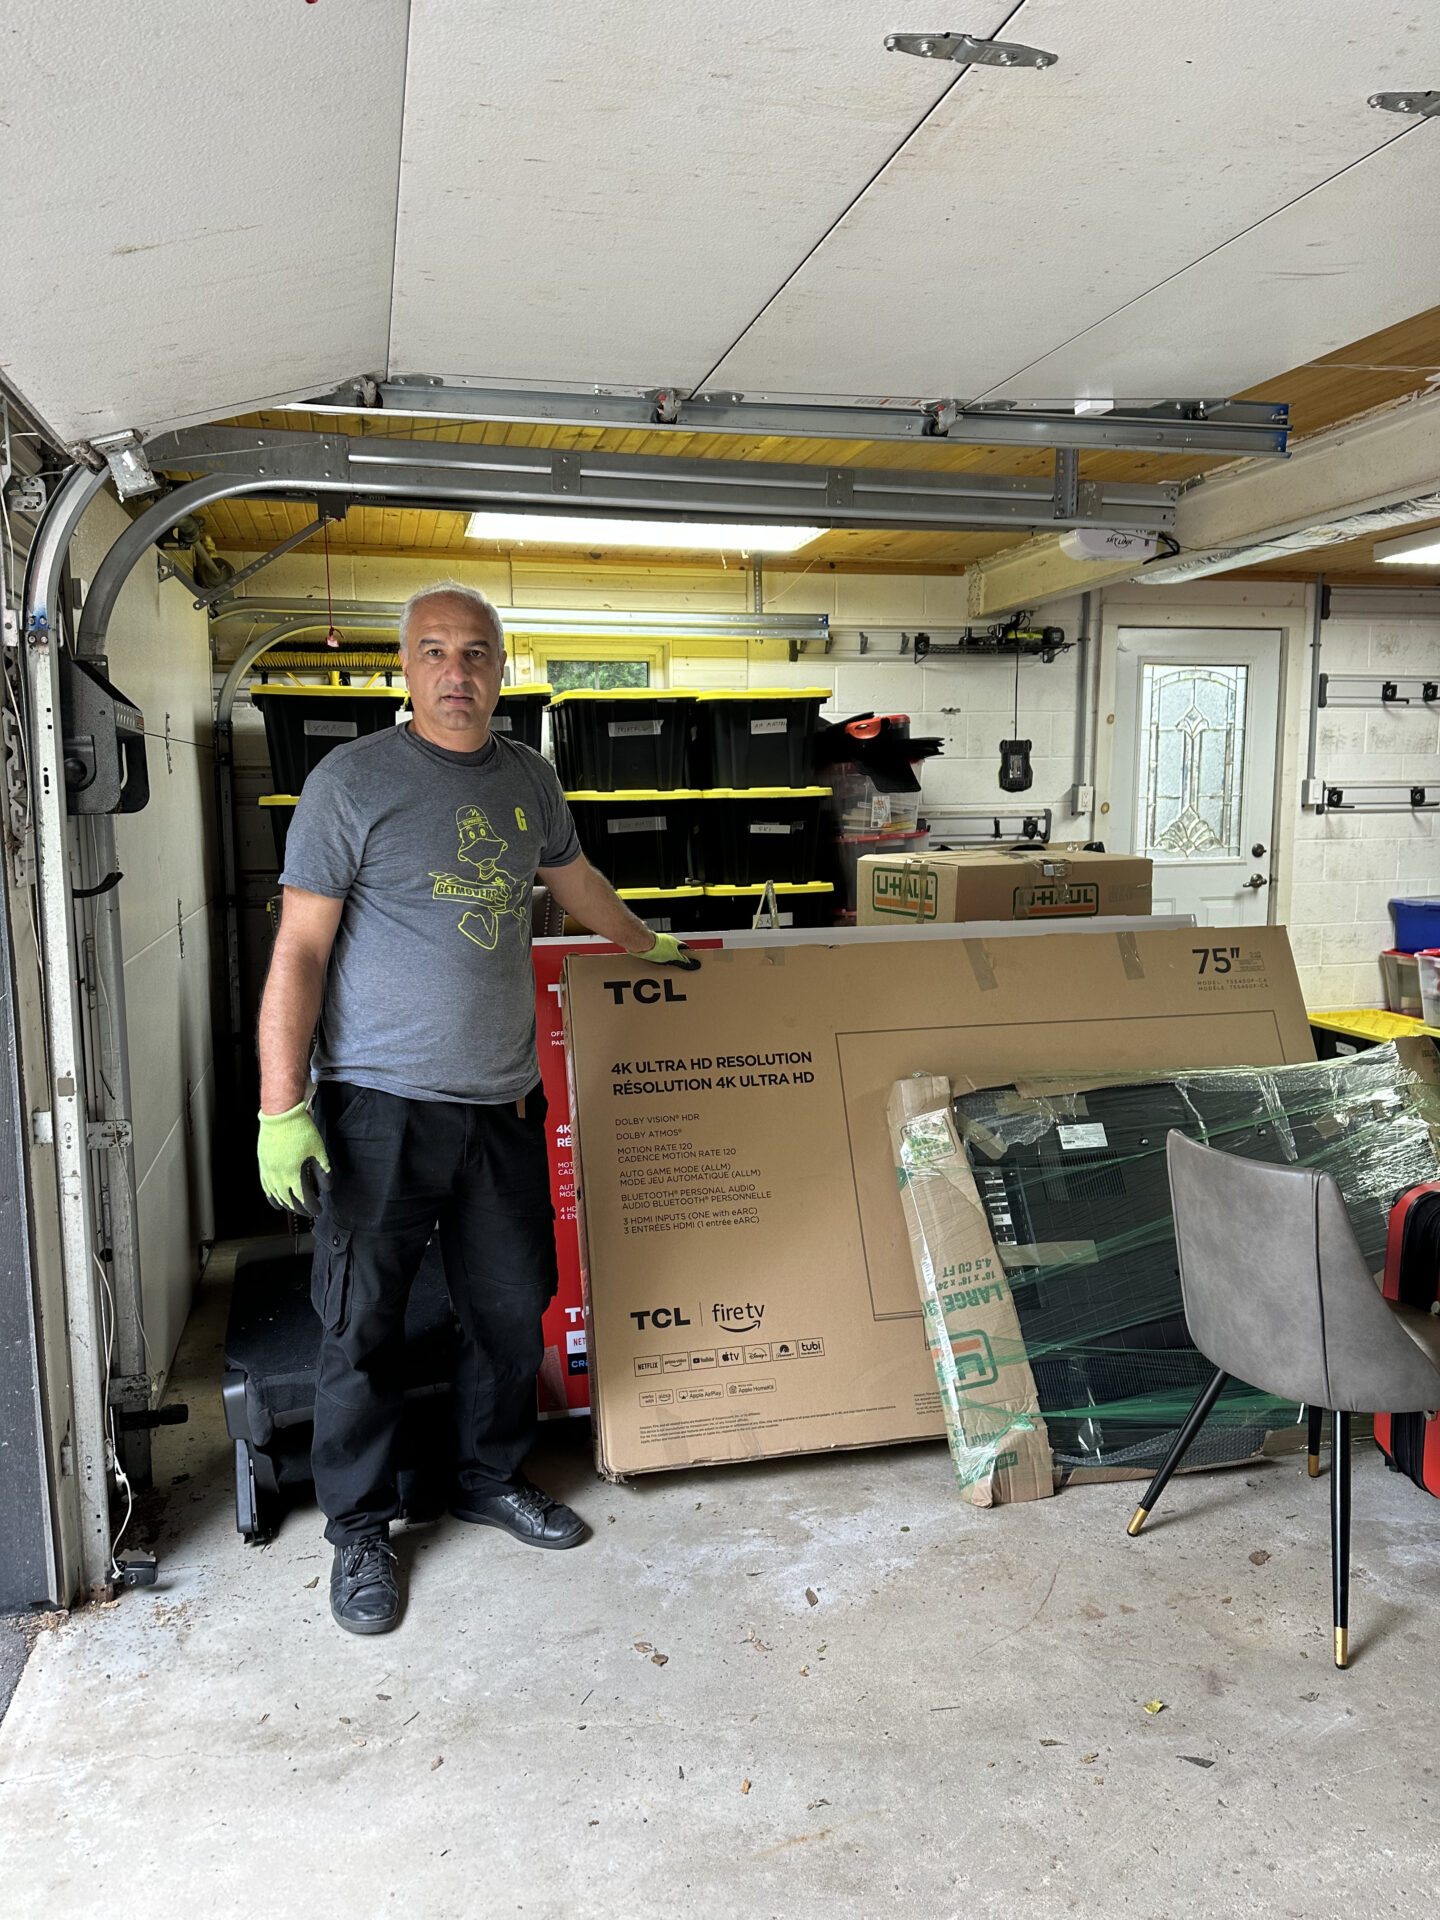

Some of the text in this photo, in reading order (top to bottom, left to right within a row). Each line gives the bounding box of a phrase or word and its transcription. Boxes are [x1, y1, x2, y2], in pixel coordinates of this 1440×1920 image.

[514, 807, 528, 831] G
[436, 881, 498, 901] GETMOVERS
[1020, 887, 1093, 906] U-HUL
[1191, 947, 1240, 974] 75"
[603, 978, 687, 1005] TCL
[611, 1051, 813, 1075] 4K ULTRA HD RESOLUTION
[613, 1071, 815, 1096] RÉSOLUTION 4K ULTRA HD
[615, 1116, 644, 1126] DOLBY
[682, 1113, 700, 1122] HDR
[557, 1135, 572, 1147] RÉ
[616, 1131, 646, 1141] DOLBY
[617, 1142, 693, 1155] MOTION RATE 120
[618, 1148, 736, 1164] CADENCE MOTION RATE 120
[620, 1163, 731, 1179] AUTO GAME MODE (ALLM)
[620, 1168, 761, 1187] MODE JEU AUTOMATIQUE (ALLM)
[680, 1186, 725, 1197] PERSONAL
[728, 1183, 756, 1193] AUDIO
[622, 1200, 651, 1210] AUDIO
[711, 1191, 772, 1202] PERSONNELLE
[623, 1207, 758, 1226] 3 HDMI INPUTS (ONE with eARC)
[623, 1216, 760, 1235] 3 ENTRÉES HDMI (1 entrée eARC)
[942, 1257, 992, 1278] 4.5 CU FT
[942, 1284, 1004, 1313] LARGE
[630, 1307, 691, 1331] TCL
[573, 1337, 586, 1347] NET
[801, 1340, 821, 1352] tubi
[571, 1359, 589, 1368] CR
[637, 1362, 659, 1371] NETFLIX
